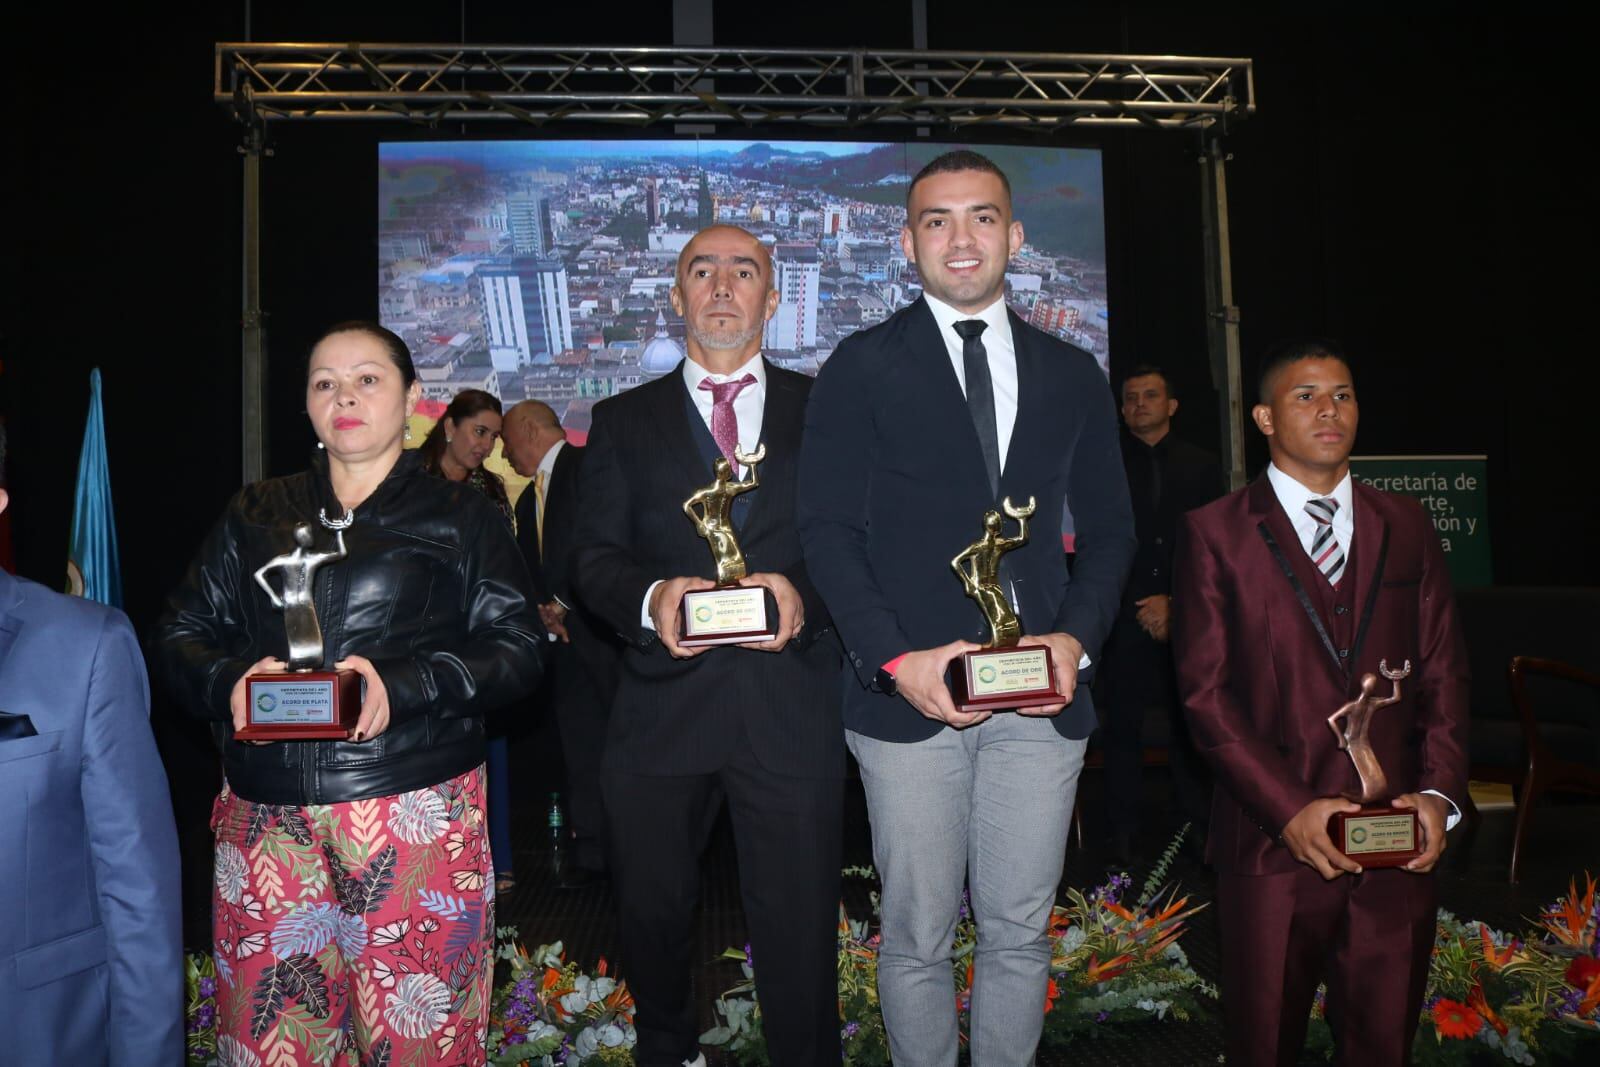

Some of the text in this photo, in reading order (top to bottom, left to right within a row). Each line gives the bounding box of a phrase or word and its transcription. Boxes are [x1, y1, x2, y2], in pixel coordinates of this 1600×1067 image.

[1352, 472, 1477, 491] ecretaría de
[1466, 517, 1477, 535] y
